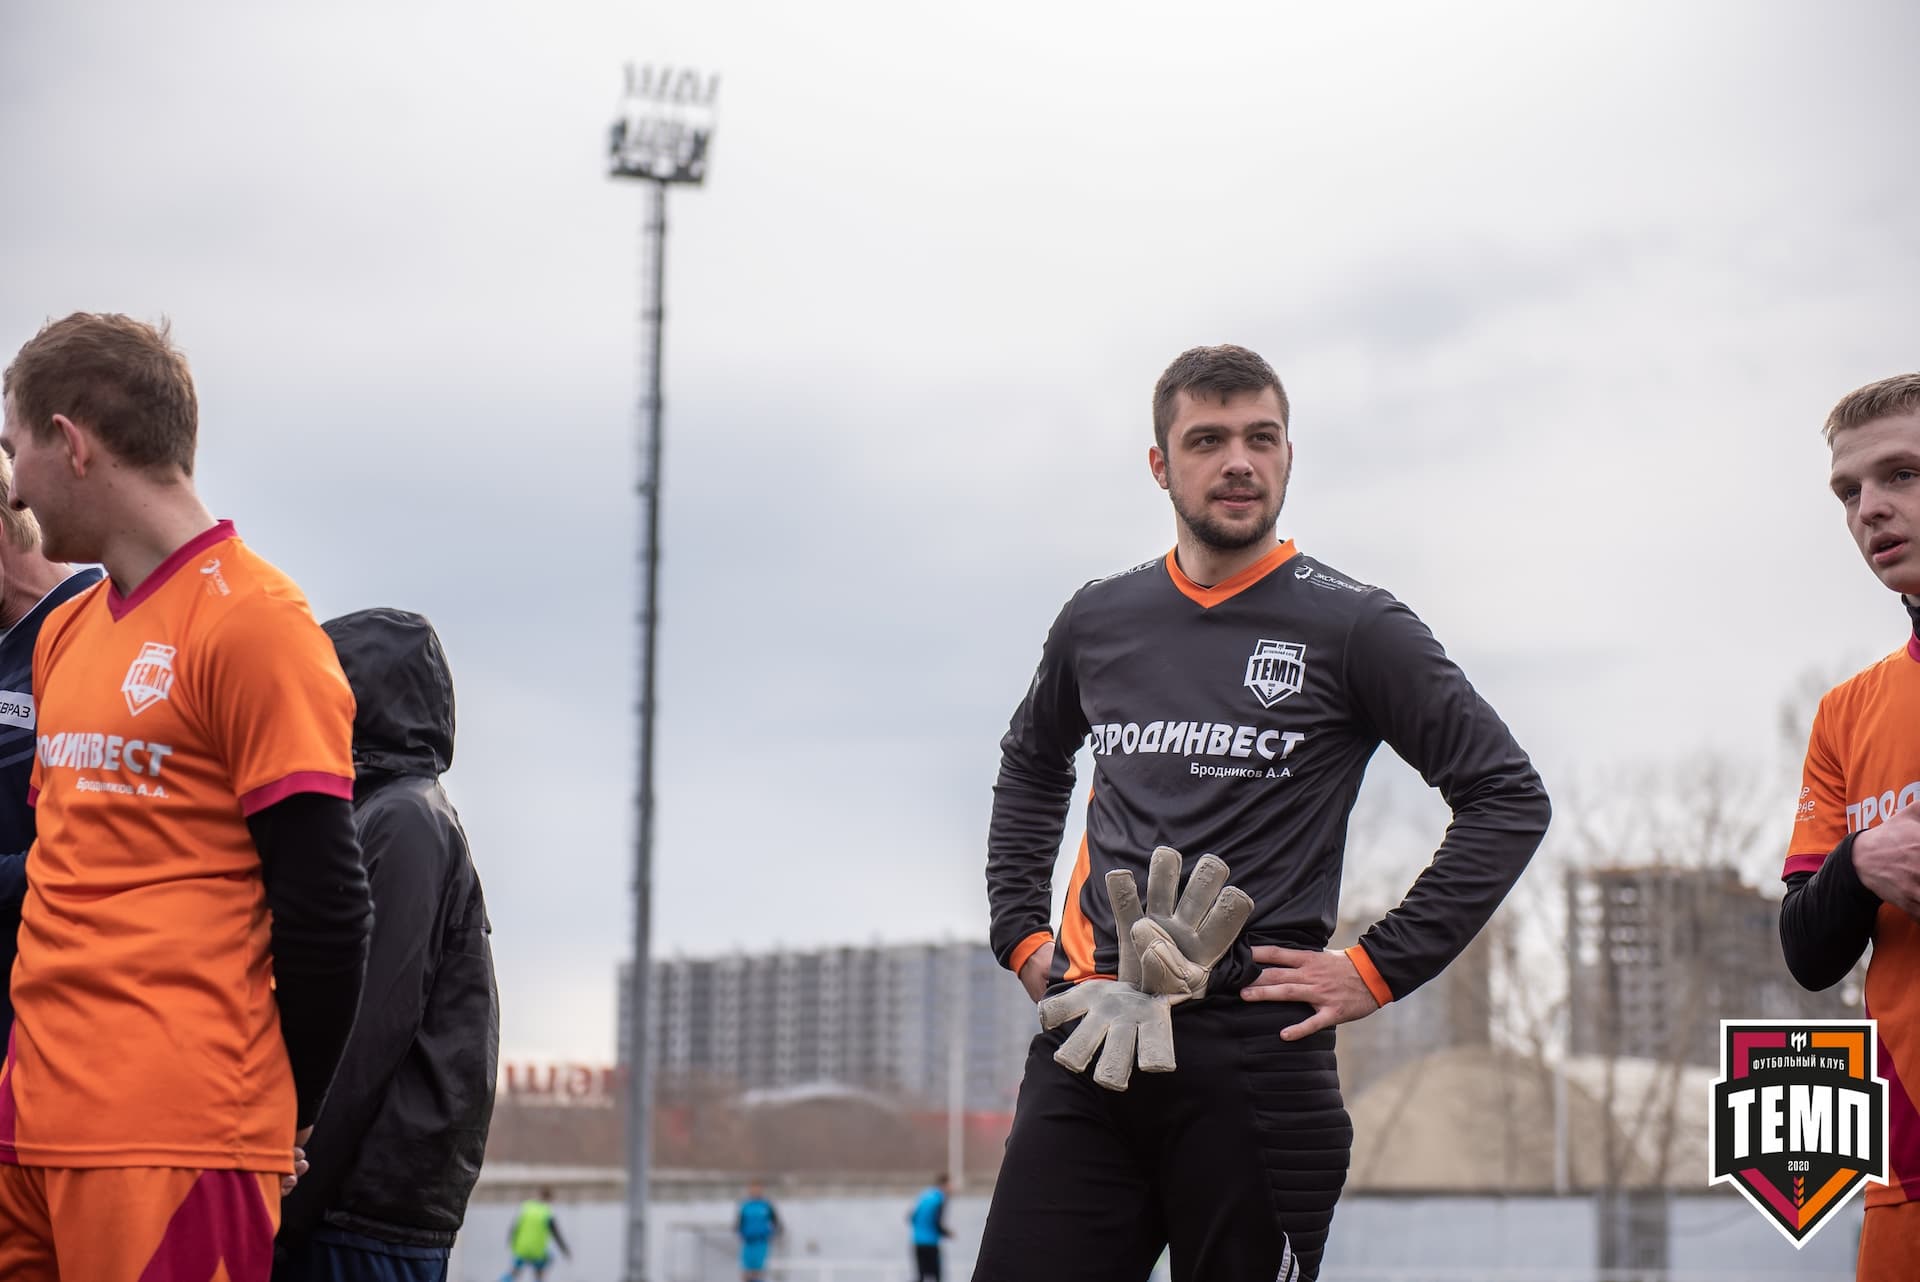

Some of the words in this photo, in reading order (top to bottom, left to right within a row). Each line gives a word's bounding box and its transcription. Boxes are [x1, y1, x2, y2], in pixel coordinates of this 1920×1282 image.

[1251, 658, 1301, 687] ТЕМП
[36, 732, 173, 776] ОДИНВЕСТ
[1091, 721, 1305, 760] ПРОДИНВЕСТ
[1190, 763, 1262, 778] Бродников
